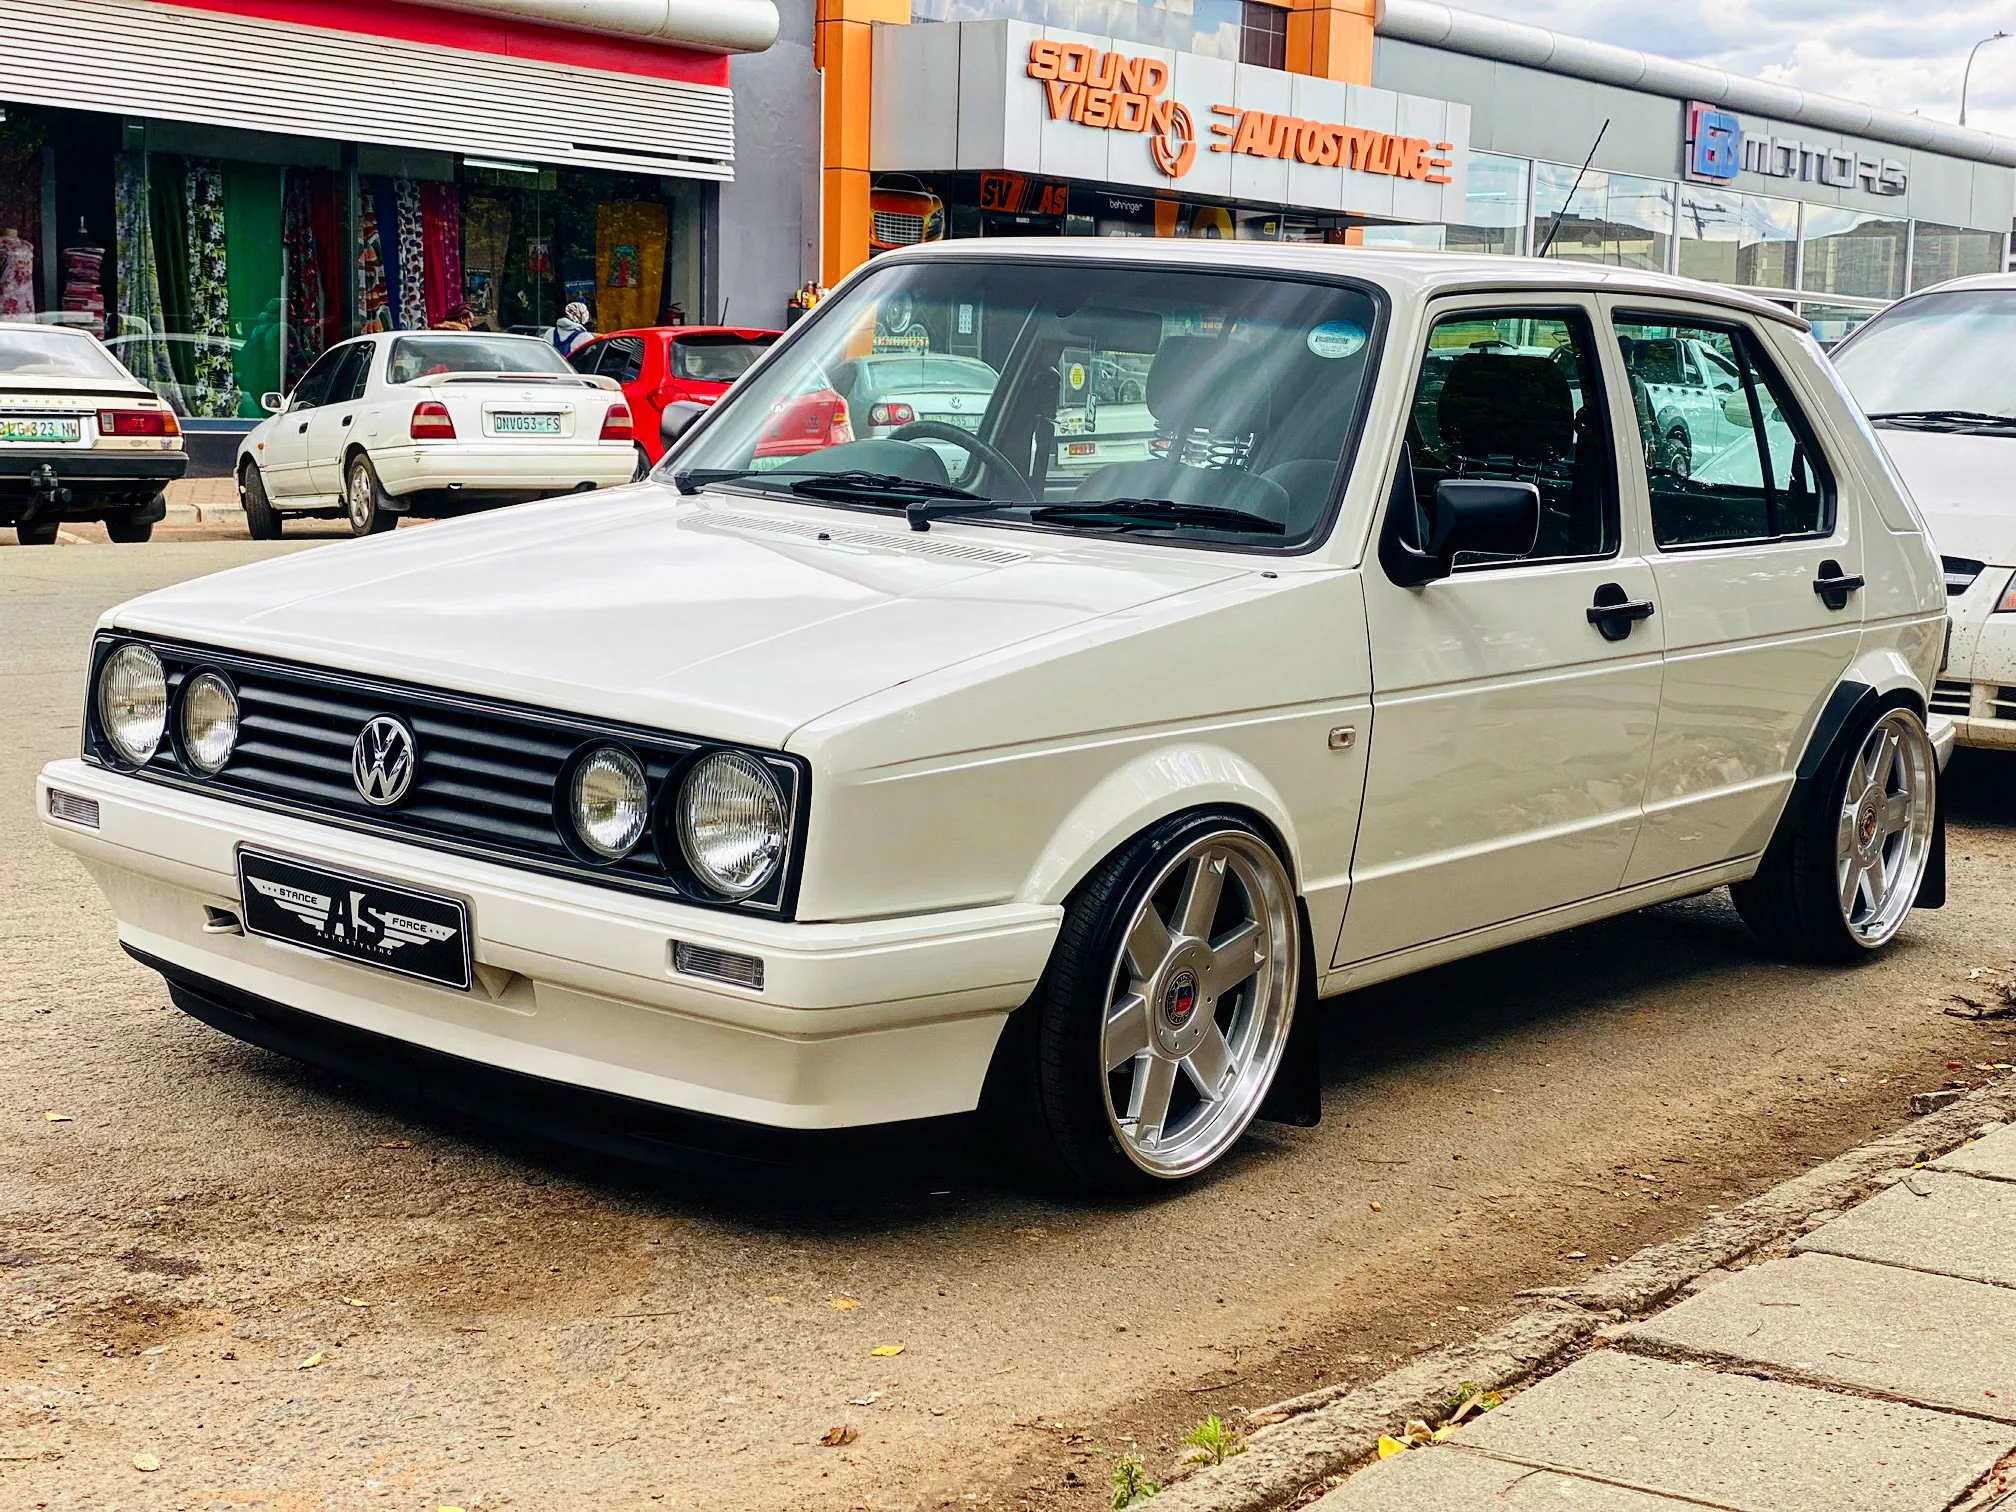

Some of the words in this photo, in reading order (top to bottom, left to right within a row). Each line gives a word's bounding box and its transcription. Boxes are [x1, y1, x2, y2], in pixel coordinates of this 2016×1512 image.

[1027, 39, 1169, 97] SOUND
[1043, 80, 1175, 136] VISION
[1233, 110, 1432, 180] AUTOSTYLING
[1741, 130, 1907, 196] MOTORS
[982, 177, 1012, 208] SV
[1039, 185, 1067, 215] AS
[1109, 198, 1143, 214] behringer
[31, 422, 54, 436] 323
[62, 422, 77, 436] NW
[496, 416, 537, 430] DNV053
[547, 417, 560, 430] FS
[279, 888, 318, 905] STANCE
[392, 917, 428, 933] FORCE
[316, 931, 393, 956] AUTOSTYLING
